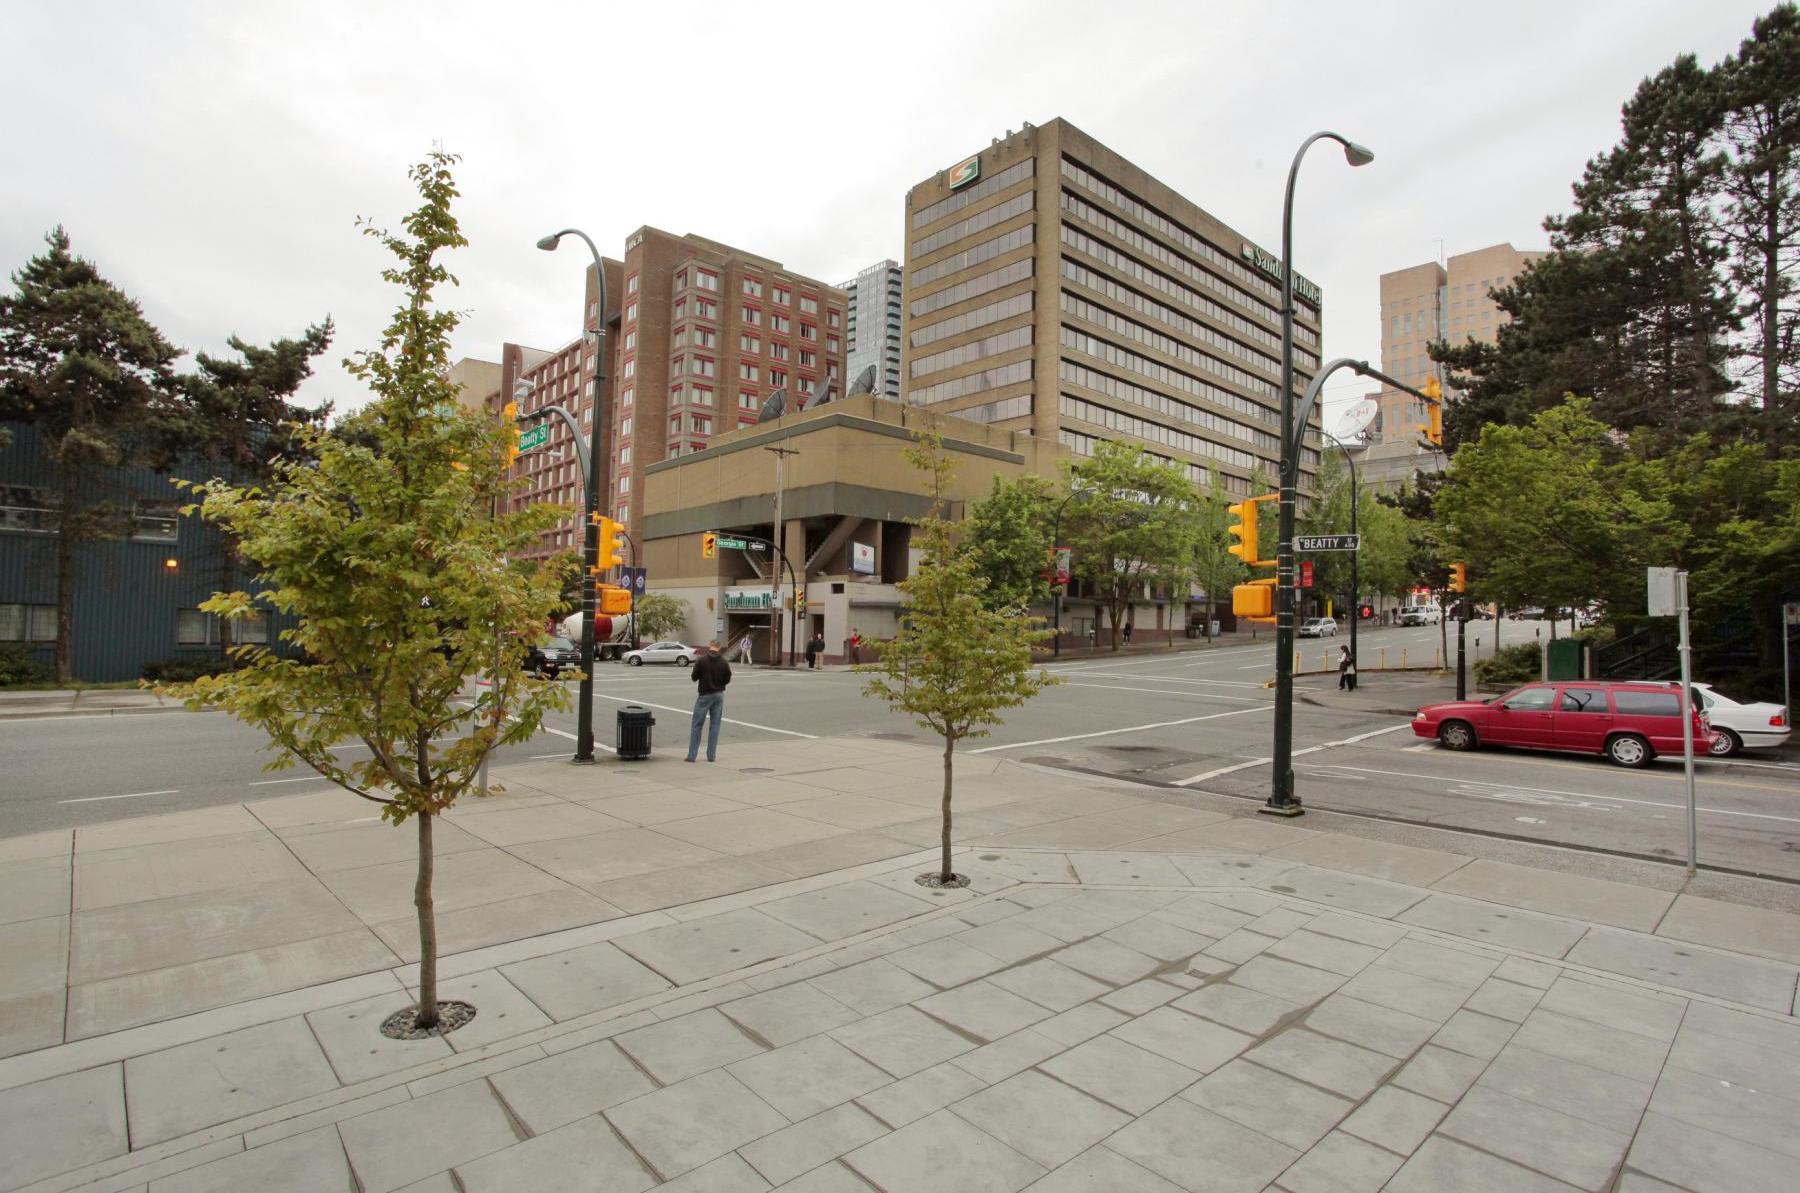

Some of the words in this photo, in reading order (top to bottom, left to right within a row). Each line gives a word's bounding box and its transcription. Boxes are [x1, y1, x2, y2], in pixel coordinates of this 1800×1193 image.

[1255, 247, 1298, 290] Sandn
[1299, 276, 1321, 305] Hotel
[520, 431, 537, 447] Beatty
[540, 426, 547, 440] St
[1304, 537, 1339, 549] BEATTY
